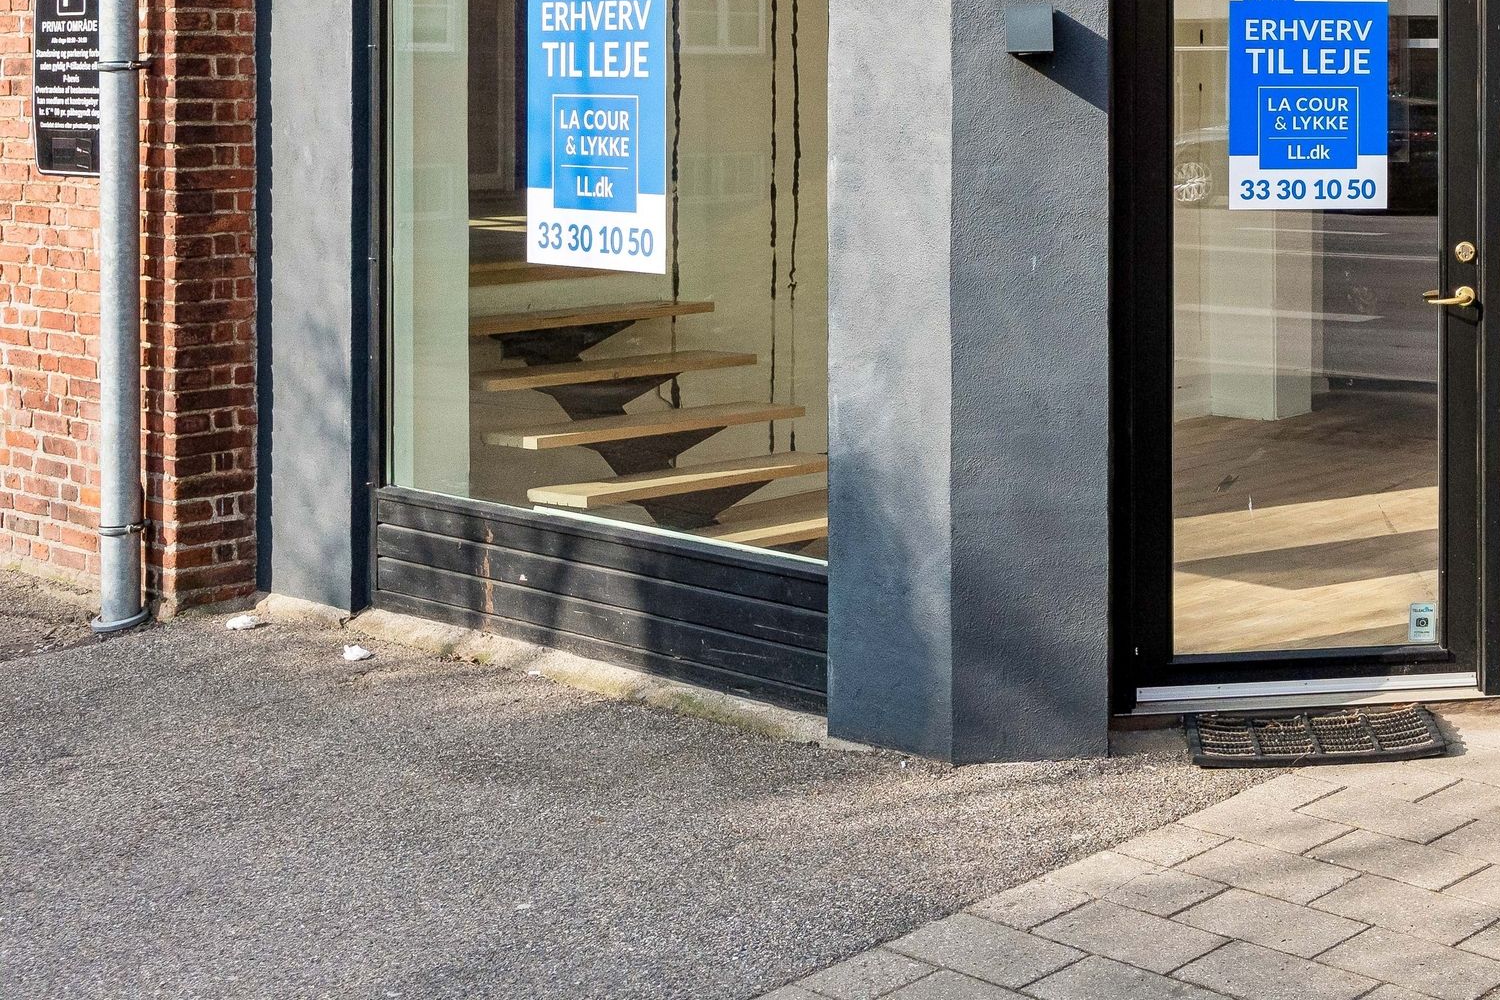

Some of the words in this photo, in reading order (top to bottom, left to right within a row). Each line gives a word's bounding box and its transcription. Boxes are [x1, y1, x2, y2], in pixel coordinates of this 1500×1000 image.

[41, 21, 66, 33] PRIVAT
[66, 18, 98, 32] OMRÅDE
[541, 0, 652, 32] ERHVERV
[1245, 19, 1373, 41] ERHVERV
[542, 41, 585, 78] TIL
[589, 41, 649, 78] LEJE
[1245, 49, 1294, 75] TIL
[1302, 49, 1371, 75] LEJE
[1268, 97, 1291, 112] LA
[1296, 97, 1349, 112] COUR
[559, 109, 580, 131] LA
[584, 109, 630, 131] COUR
[1274, 116, 1288, 130] &
[1292, 116, 1349, 130] LYKKE
[565, 135, 577, 155] &
[580, 136, 630, 157] LYKKE
[1287, 144, 1330, 160] LL.dk
[576, 174, 614, 198] LL.dk
[1240, 179, 1270, 200] 33
[1276, 179, 1306, 200] 30
[1313, 179, 1341, 200] 10
[1347, 178, 1376, 200] 50
[538, 222, 563, 250] 33
[568, 223, 593, 253] 30
[599, 225, 623, 255] 10
[628, 228, 654, 257] 50
